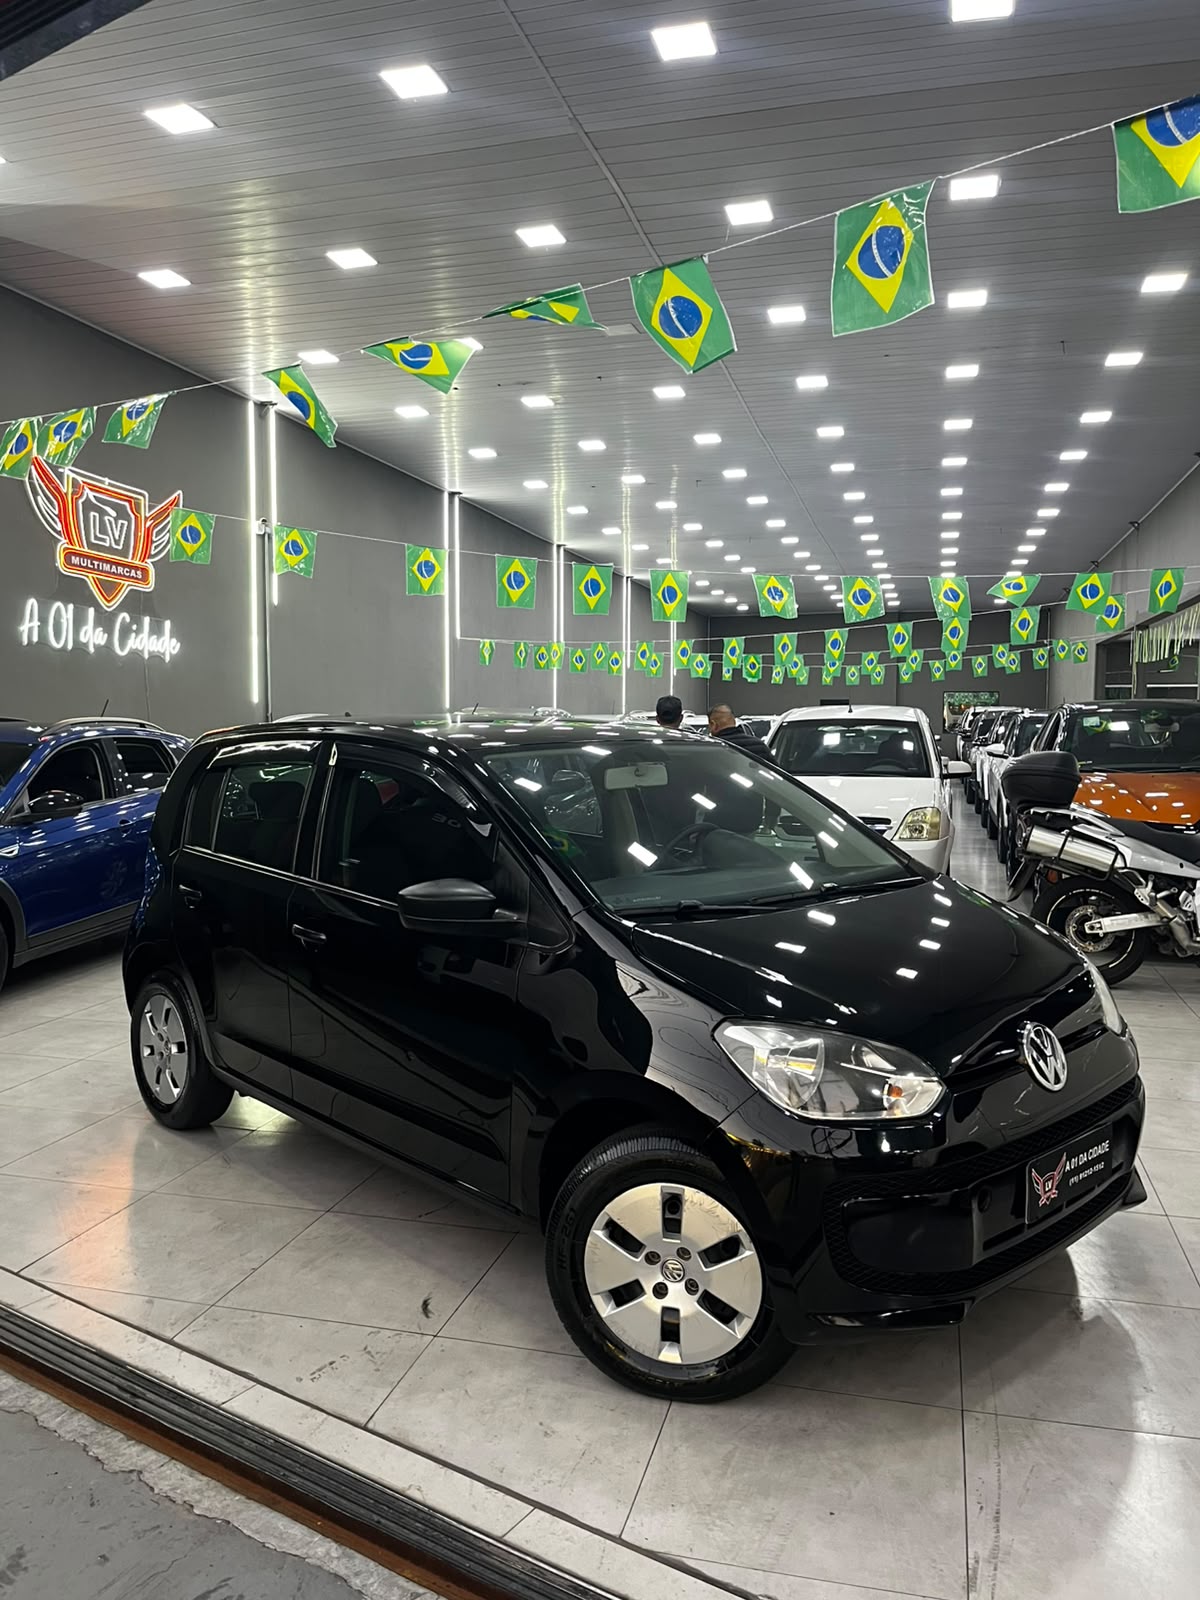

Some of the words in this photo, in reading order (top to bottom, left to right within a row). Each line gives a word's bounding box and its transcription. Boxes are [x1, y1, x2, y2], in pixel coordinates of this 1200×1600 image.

[90, 511, 128, 550] LV
[71, 554, 143, 580] MULTIMARCAS
[19, 598, 41, 646] A
[80, 607, 108, 654] da
[114, 612, 181, 663] Cidade
[1065, 1160, 1071, 1173] A
[1071, 1156, 1078, 1169] 01
[1079, 1152, 1088, 1165] DA
[1088, 1139, 1110, 1161] CIDADE
